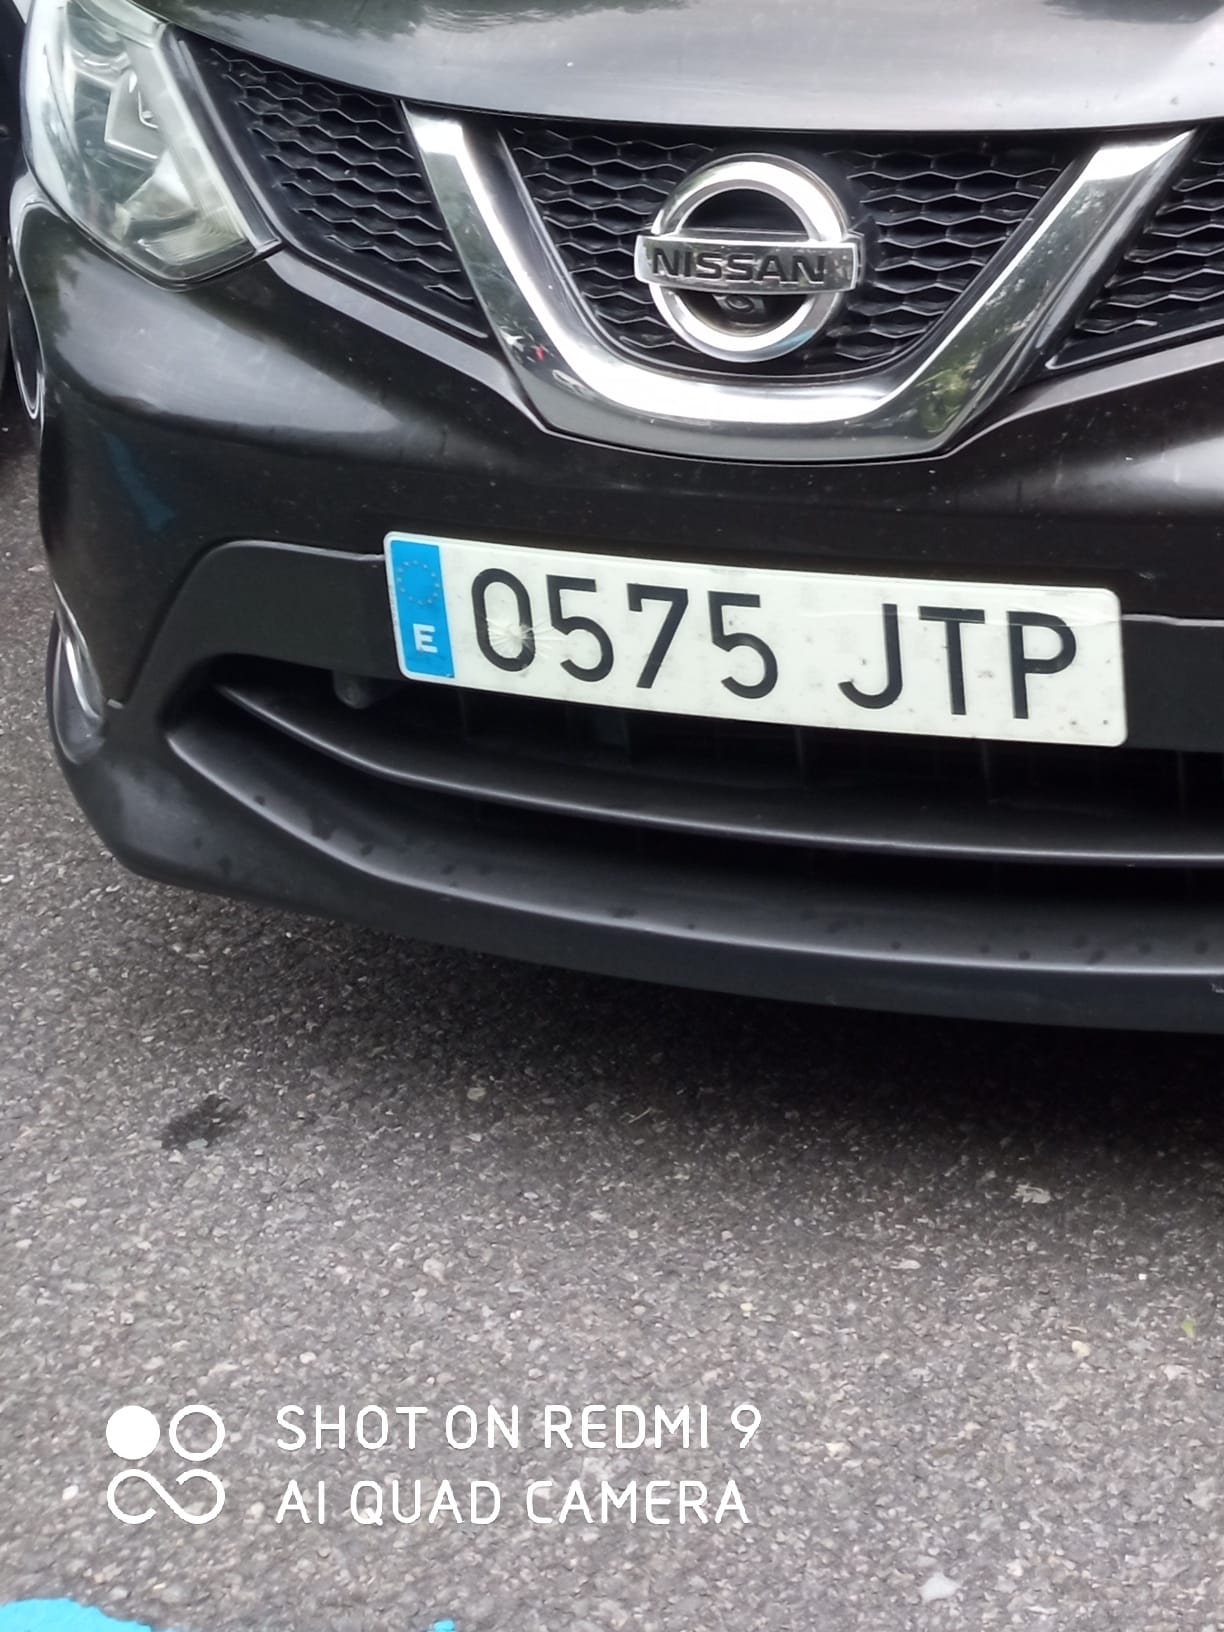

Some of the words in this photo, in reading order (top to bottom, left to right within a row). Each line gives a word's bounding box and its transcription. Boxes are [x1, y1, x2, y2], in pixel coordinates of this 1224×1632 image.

[652, 248, 827, 285] NISSAN
[414, 624, 438, 654] E
[470, 567, 779, 700] 0575
[838, 602, 1077, 720] JTP
